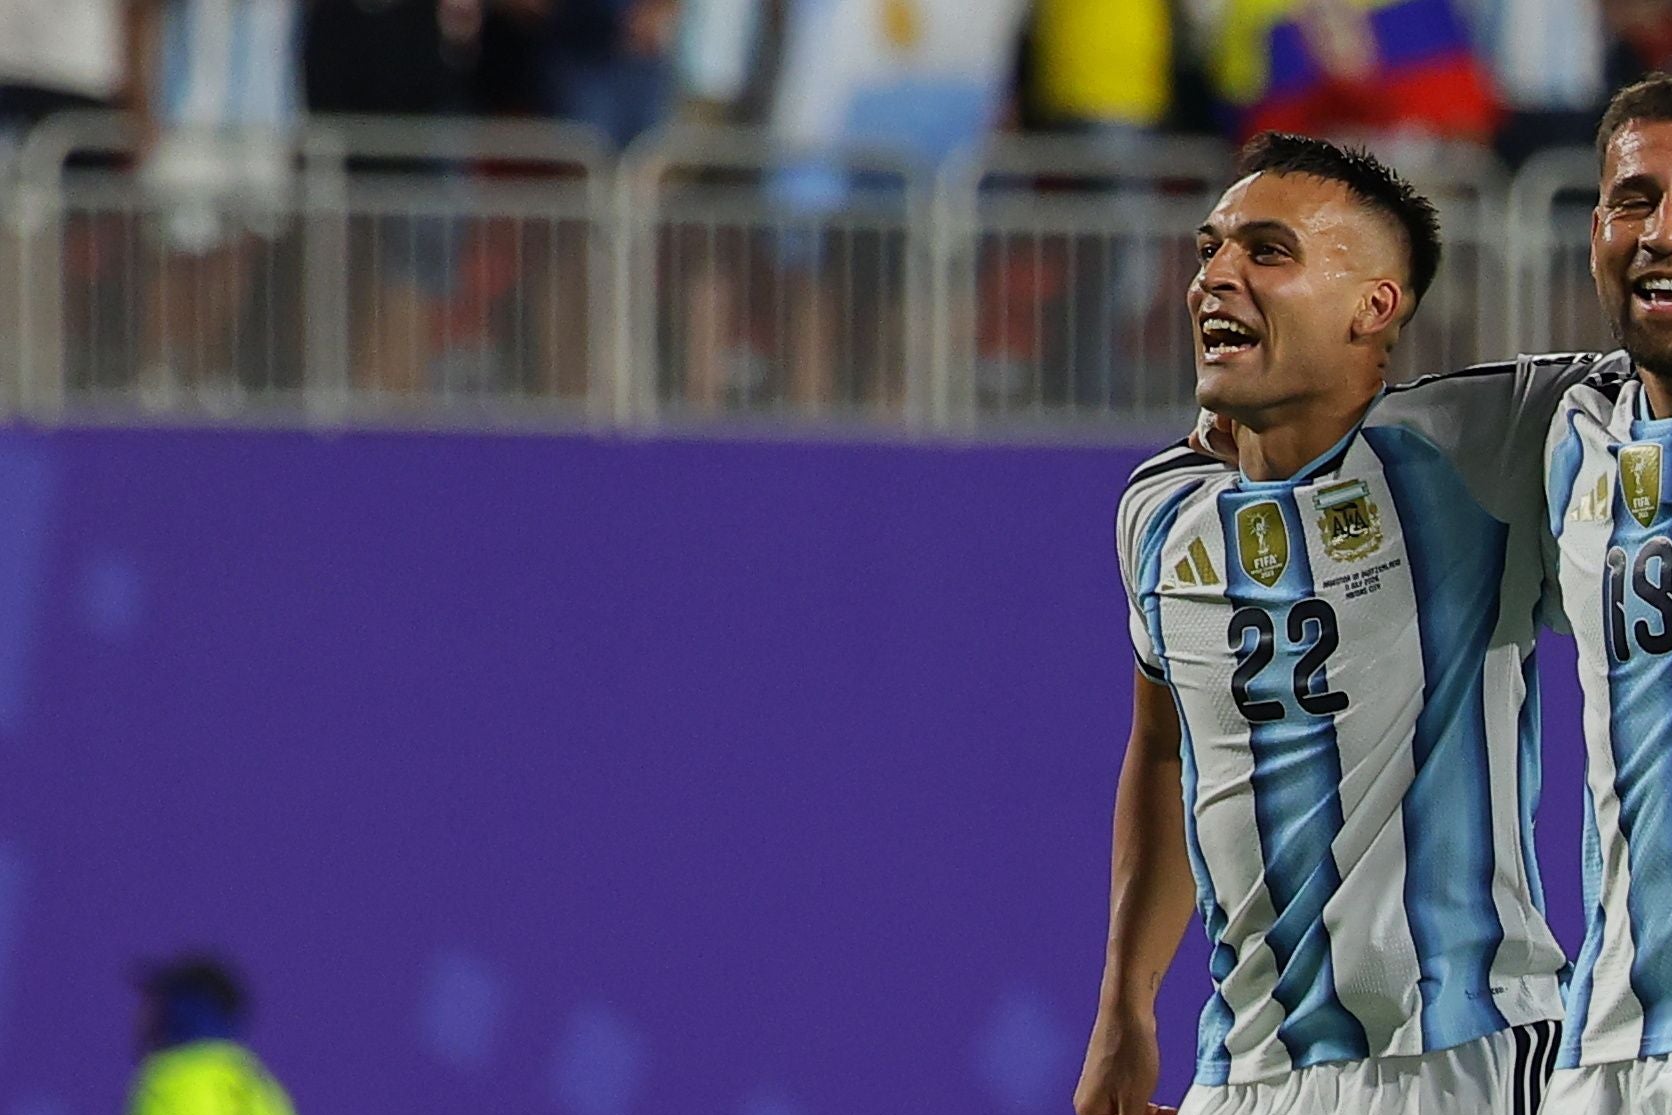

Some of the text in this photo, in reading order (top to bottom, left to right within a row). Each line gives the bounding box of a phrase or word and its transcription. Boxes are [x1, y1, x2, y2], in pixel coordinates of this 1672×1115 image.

[1633, 496, 1650, 509] FIFA
[1253, 555, 1277, 570] FIFA
[1227, 597, 1350, 724] 22
